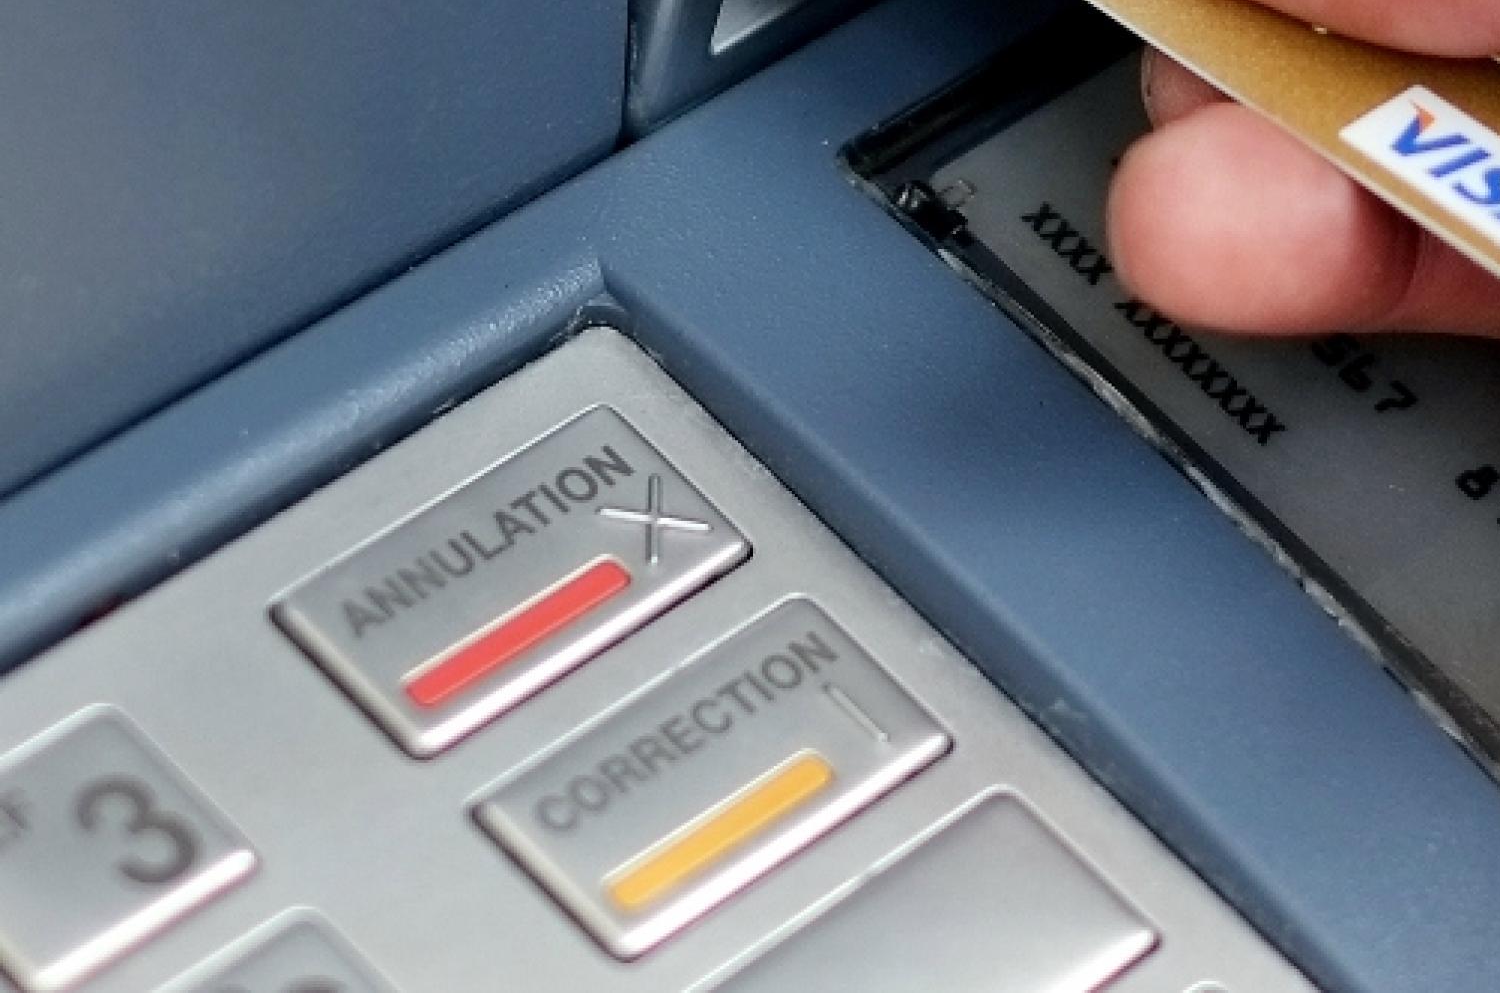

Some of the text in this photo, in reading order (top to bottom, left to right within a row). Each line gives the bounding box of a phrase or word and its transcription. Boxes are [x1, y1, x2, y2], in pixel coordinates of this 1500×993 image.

[343, 445, 636, 638] ANNULATION
[535, 630, 840, 834] CORRECTION
[73, 772, 201, 886] 3
